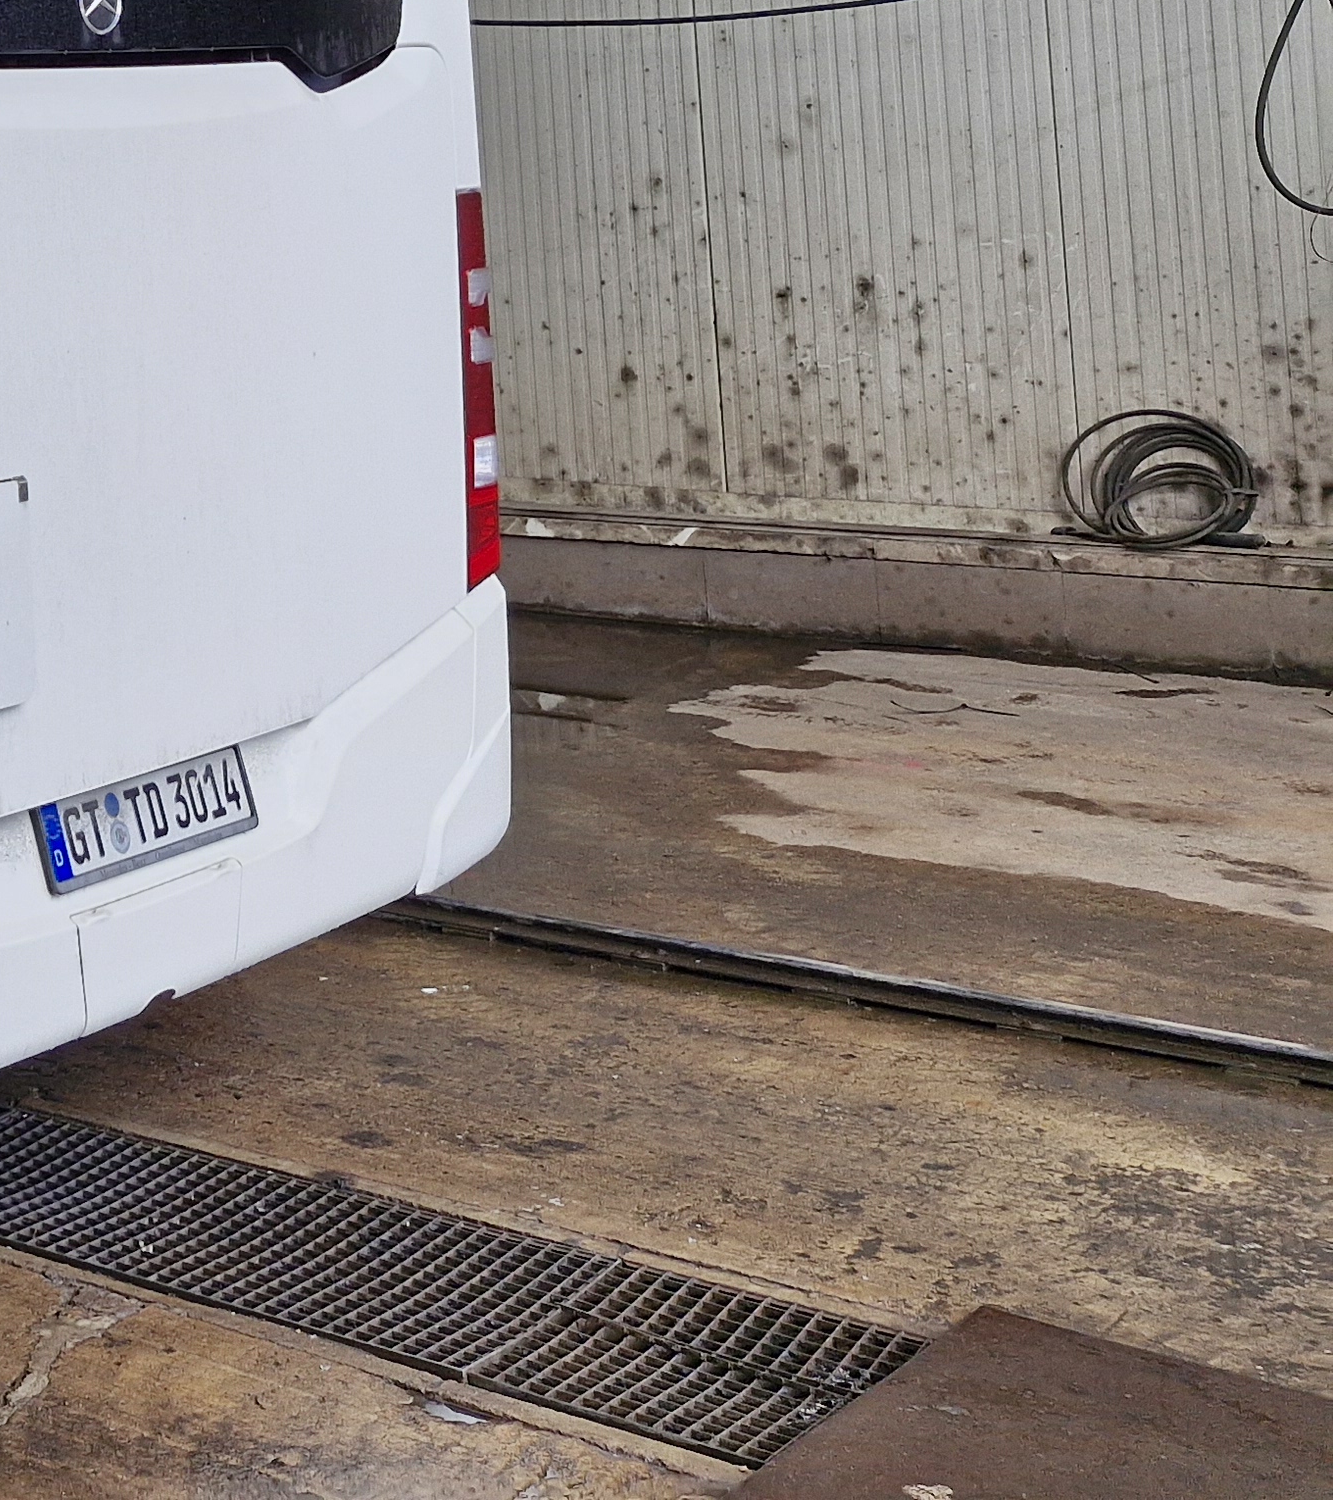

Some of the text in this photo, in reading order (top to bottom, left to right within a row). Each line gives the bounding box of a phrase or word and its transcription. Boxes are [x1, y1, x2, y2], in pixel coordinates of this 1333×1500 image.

[64, 798, 106, 865] GT
[123, 781, 169, 844] TD
[166, 758, 242, 829] 3014
[53, 849, 64, 868] D
